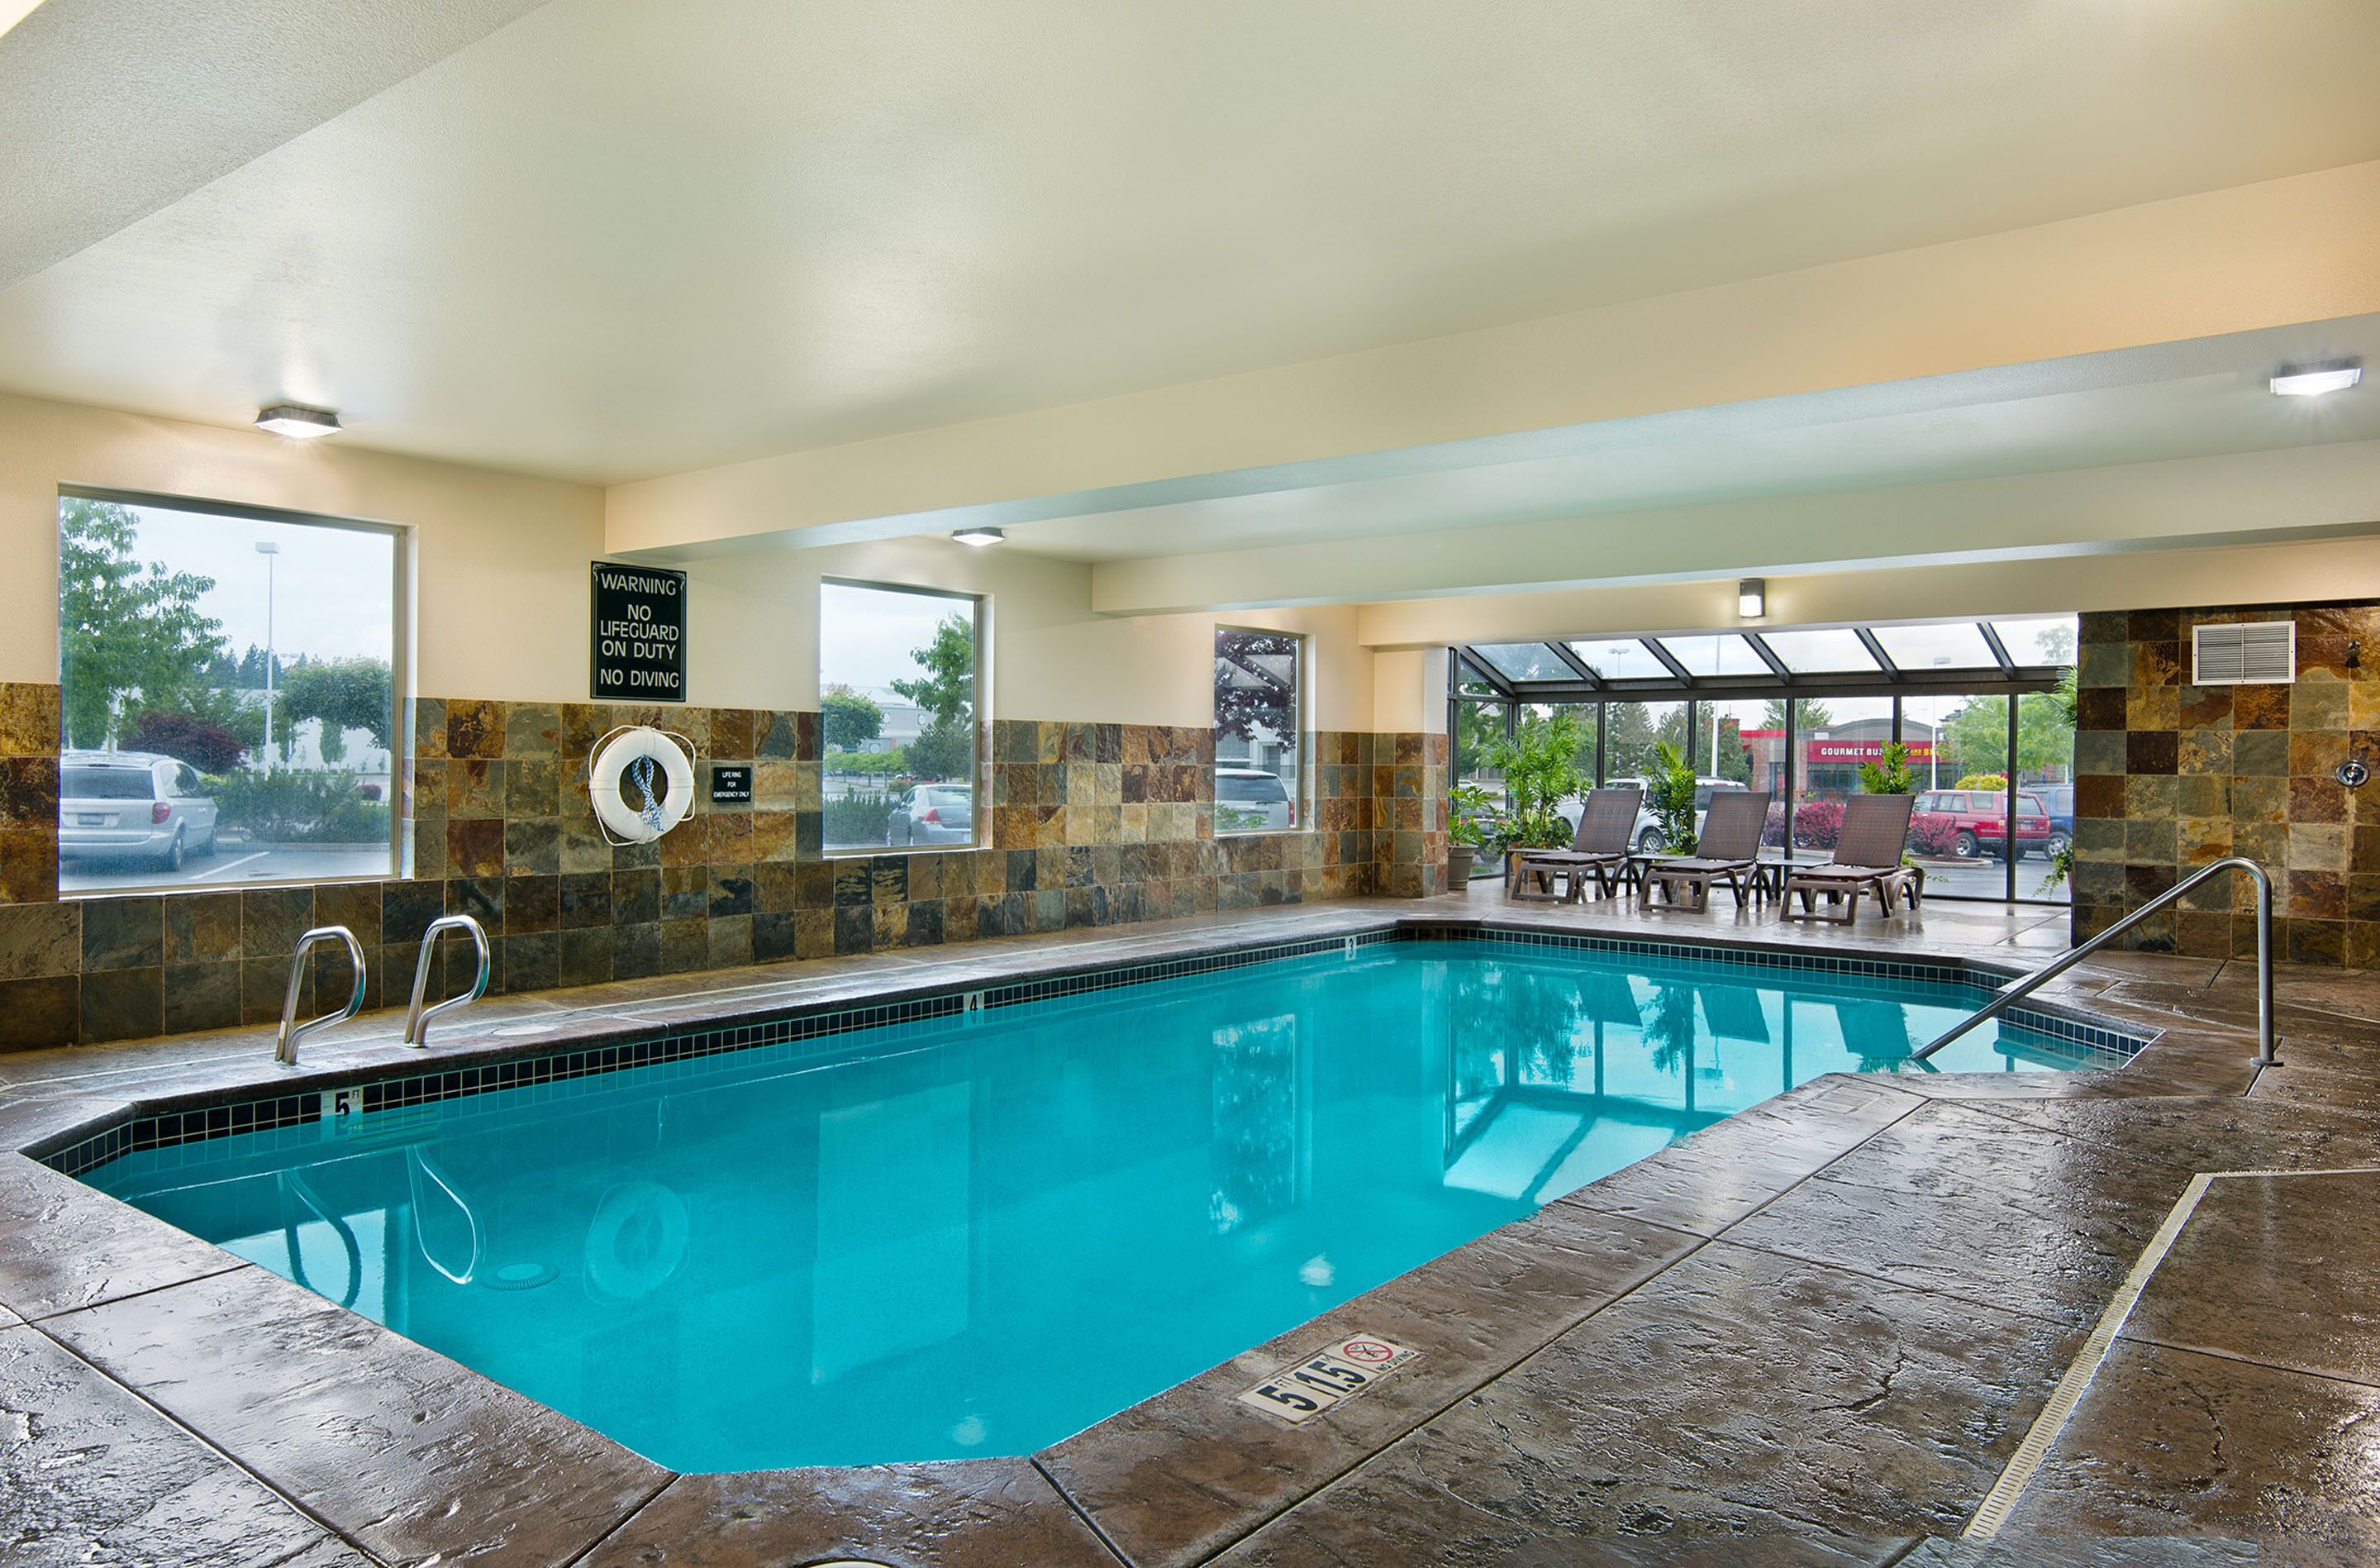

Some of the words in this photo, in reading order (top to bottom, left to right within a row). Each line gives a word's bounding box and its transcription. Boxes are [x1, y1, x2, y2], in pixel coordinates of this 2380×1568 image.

[601, 573, 676, 596] WARNING
[627, 604, 651, 621] NO
[600, 620, 679, 641] LIFEGUARD
[602, 640, 626, 657] ON
[634, 642, 676, 660] DUTY
[600, 669, 624, 685] NO
[631, 670, 679, 688] DIVING
[1821, 747, 1864, 755] GOURMET
[969, 994, 978, 1011] 4
[335, 1091, 350, 1117] 5
[352, 1089, 359, 1099] FT
[1274, 1379, 1292, 1389] FT
[1293, 1361, 1367, 1394] 1.5
[1256, 1385, 1319, 1411] 5
